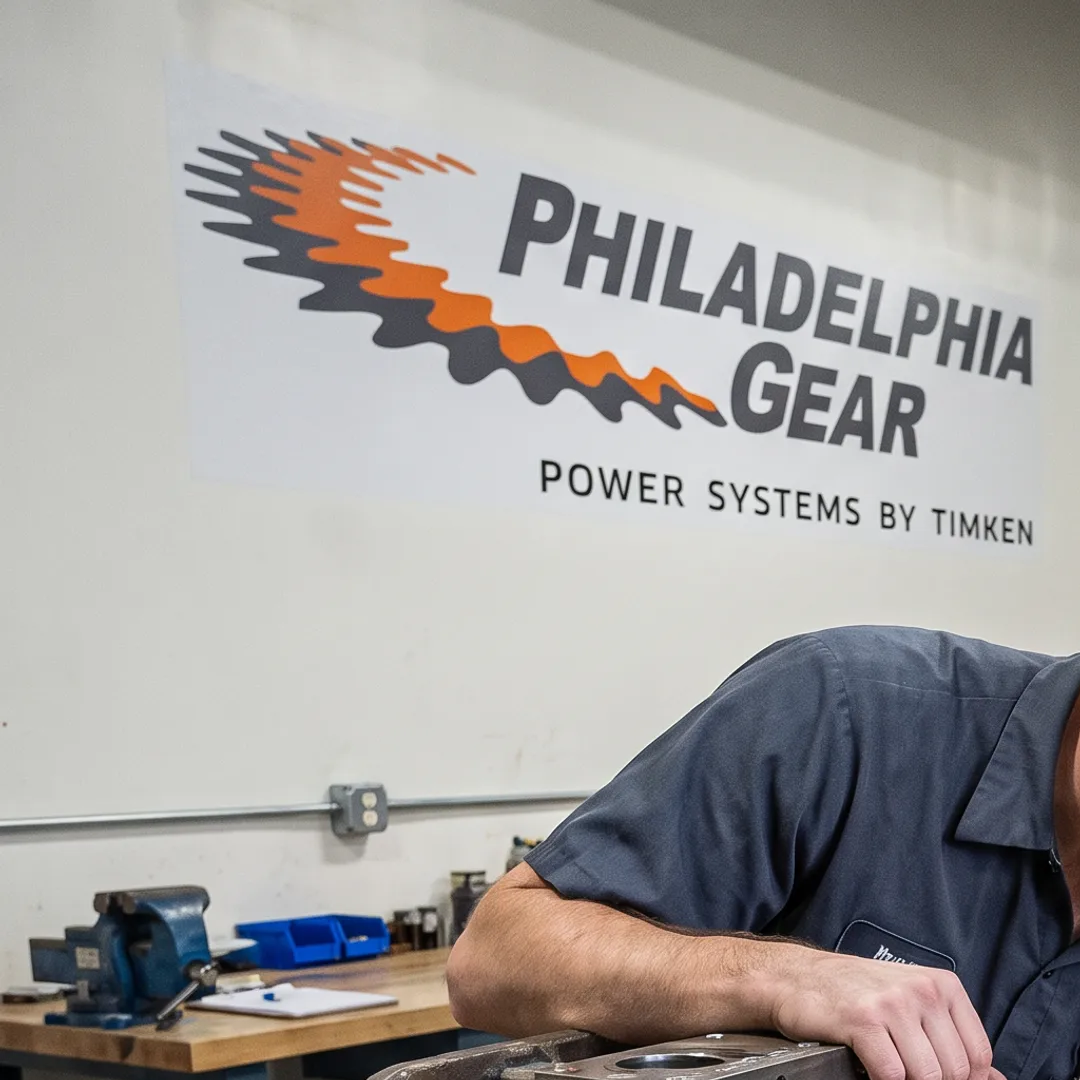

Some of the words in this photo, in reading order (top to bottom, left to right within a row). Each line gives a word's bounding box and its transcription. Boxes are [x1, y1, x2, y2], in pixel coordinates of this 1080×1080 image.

[498, 172, 1033, 386] PHILADELPHIA
[730, 341, 926, 458] GEAR
[541, 459, 685, 507] POWER
[708, 480, 861, 527] SYSTEMS
[880, 501, 916, 532] BY
[931, 508, 1034, 546] TIMKEN
